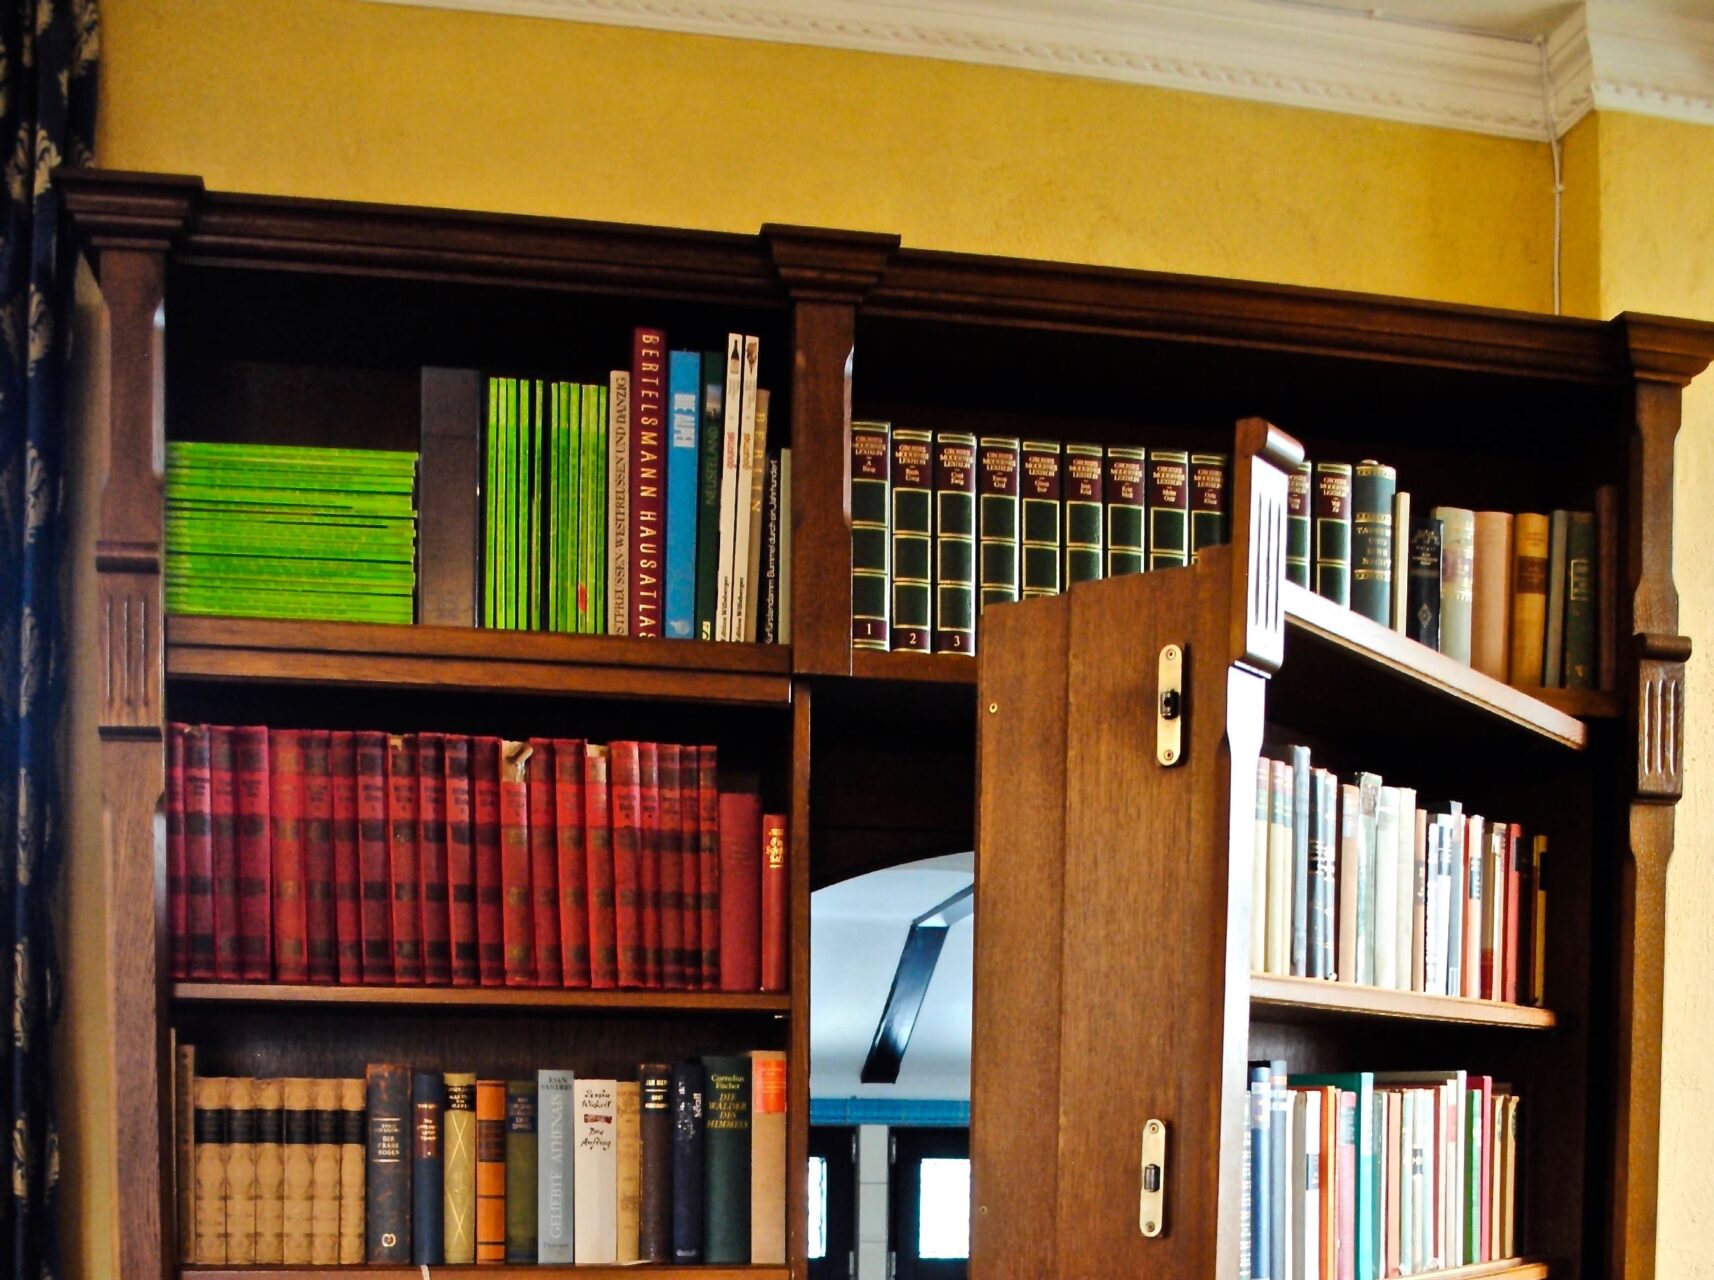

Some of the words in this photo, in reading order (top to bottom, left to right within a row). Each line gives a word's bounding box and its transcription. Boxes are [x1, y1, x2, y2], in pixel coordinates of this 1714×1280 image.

[615, 376, 627, 428] DANZIG
[639, 334, 660, 498] BERTELSMANN
[752, 411, 766, 513] BERLIN
[639, 510, 658, 639] HAUSATLAS
[867, 623, 871, 635] 1
[909, 633, 916, 644] 2
[954, 635, 960, 647] 3
[710, 1073, 745, 1082] Cornelius
